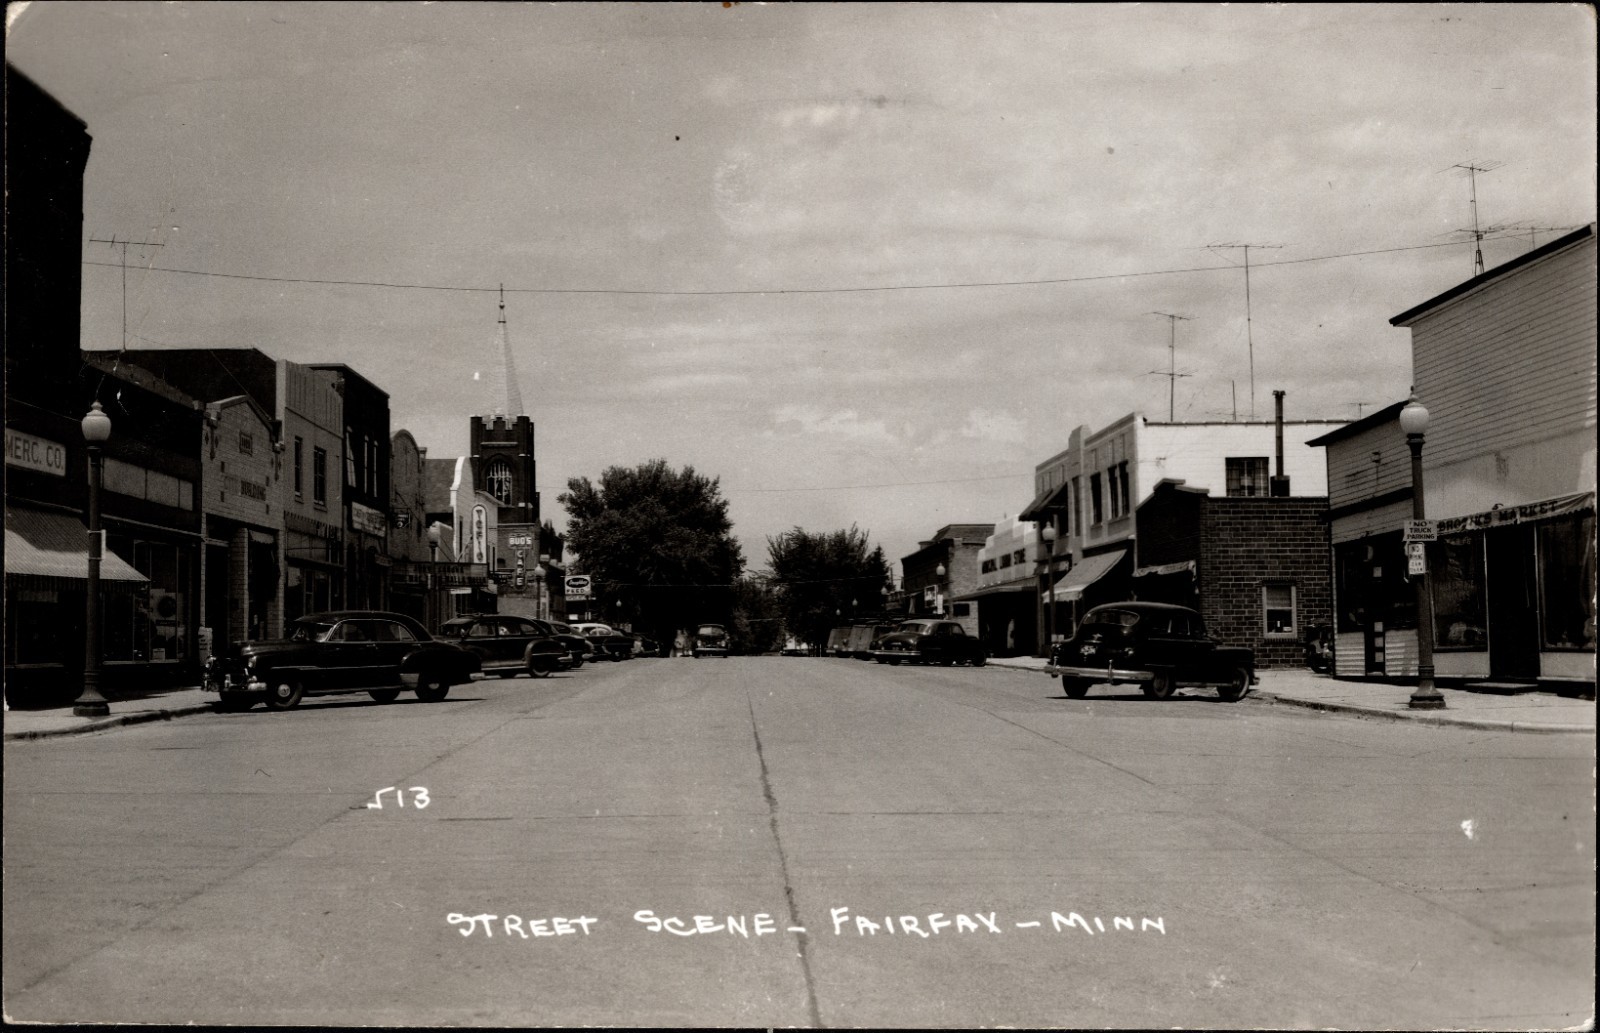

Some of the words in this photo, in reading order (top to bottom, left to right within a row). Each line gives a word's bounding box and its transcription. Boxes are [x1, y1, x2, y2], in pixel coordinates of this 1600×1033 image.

[46, 445, 64, 470] CO.
[1498, 500, 1558, 521] MARKET
[516, 550, 525, 586] CAFE
